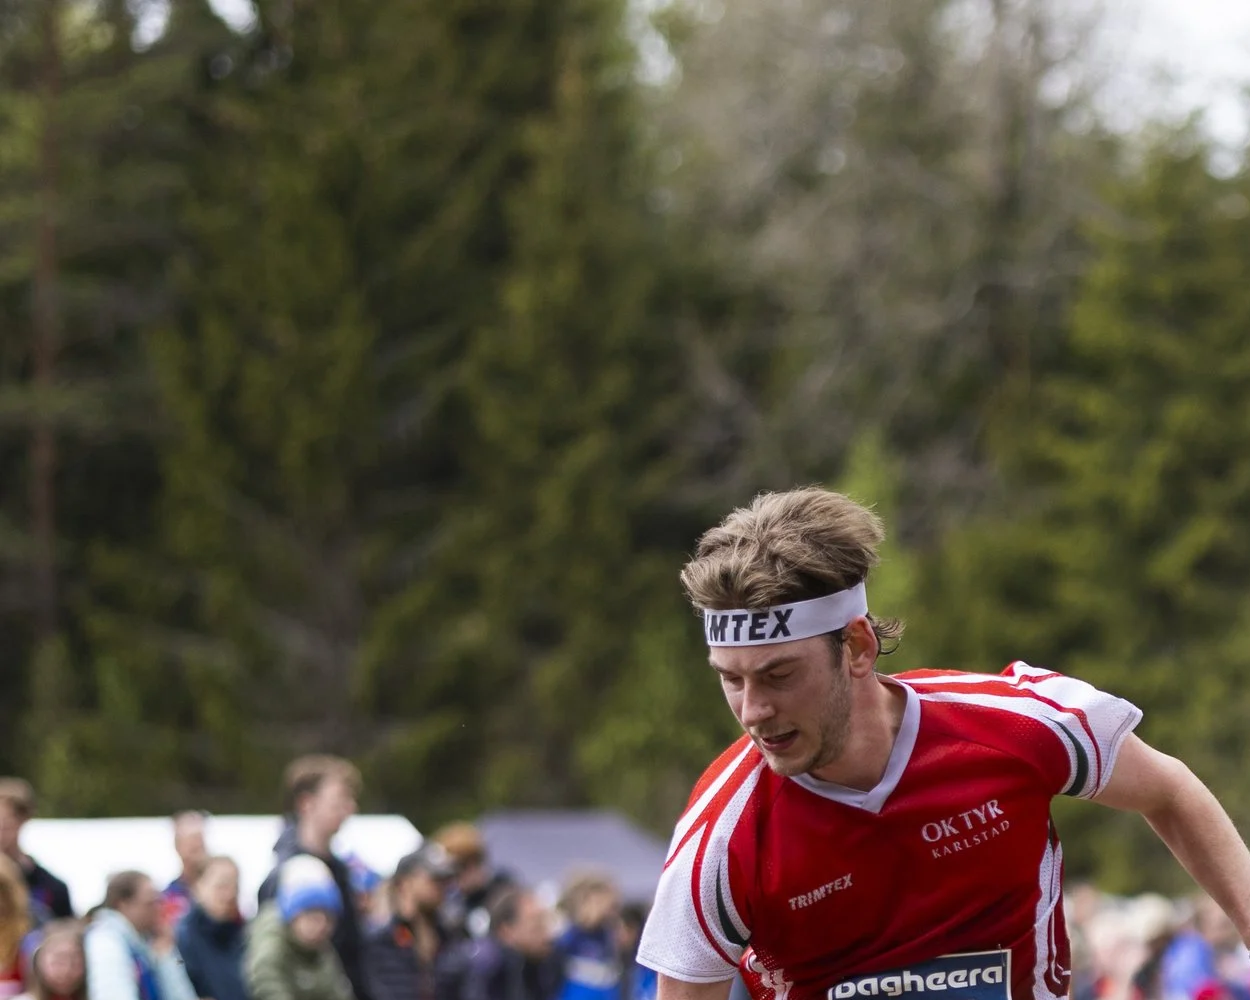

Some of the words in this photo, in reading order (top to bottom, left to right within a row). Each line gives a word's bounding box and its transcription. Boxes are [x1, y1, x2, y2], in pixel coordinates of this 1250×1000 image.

[921, 817, 960, 843] OK
[958, 799, 1004, 830] TYR
[932, 820, 1011, 859] KARLSTAD
[788, 873, 853, 911] TRIMTEX
